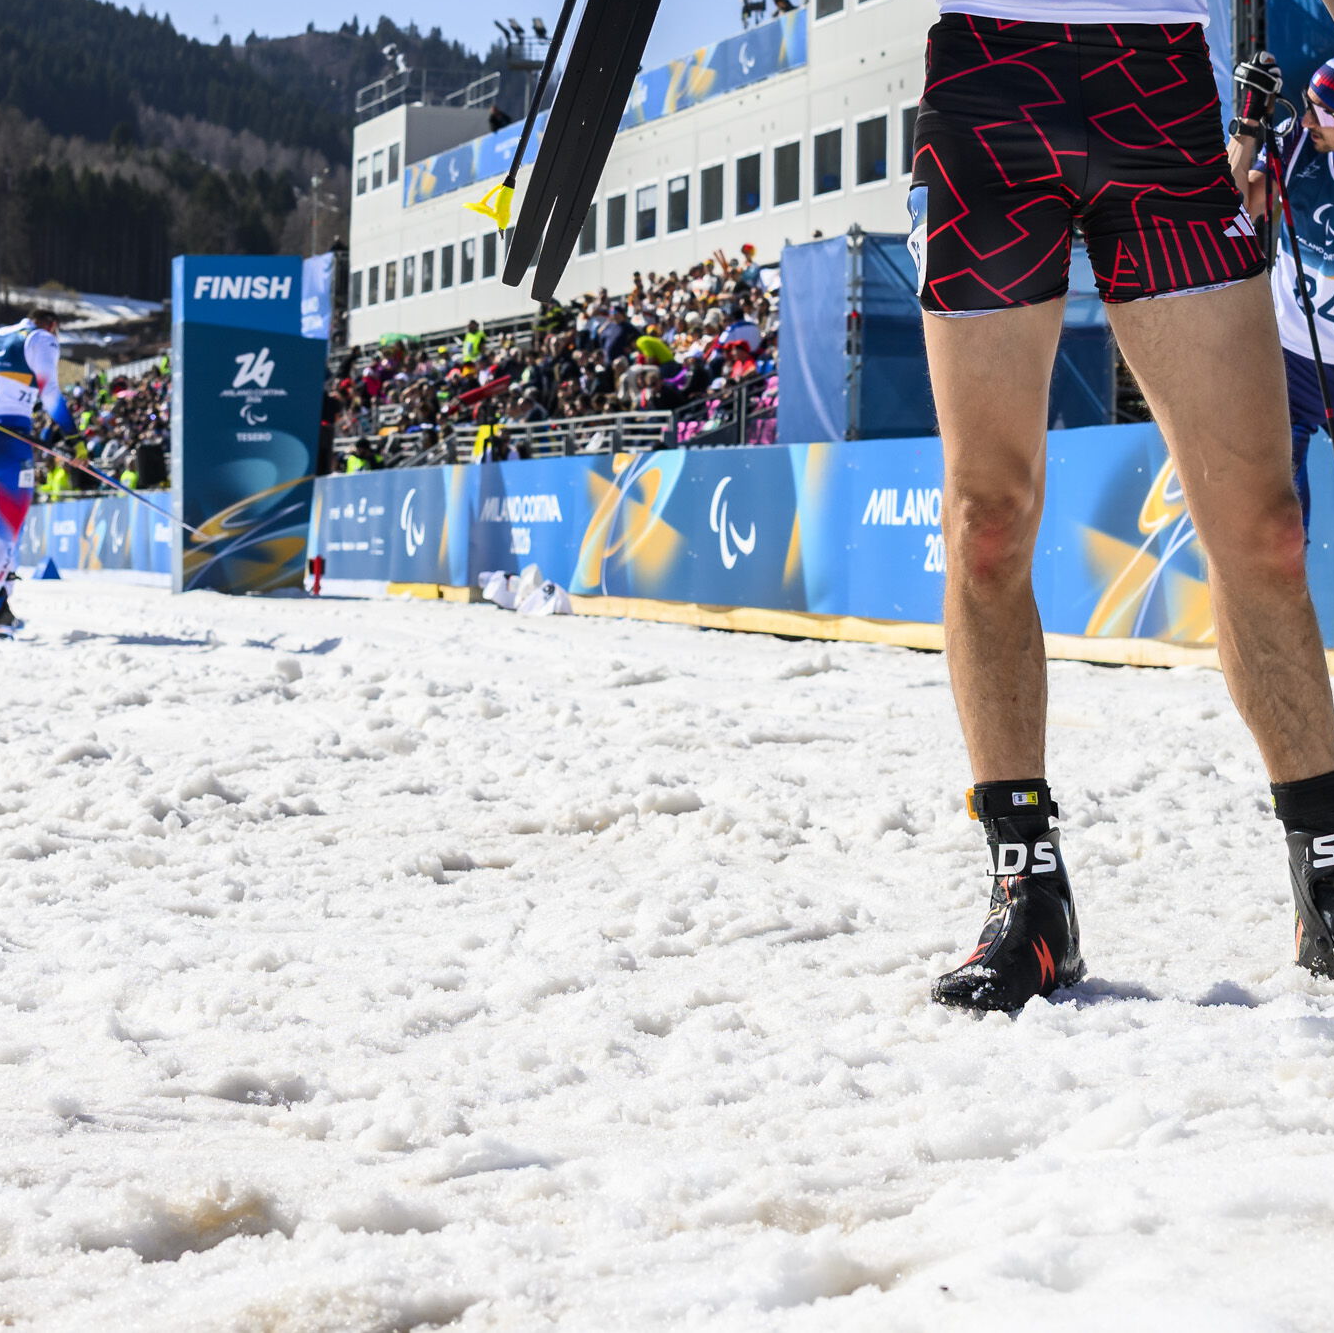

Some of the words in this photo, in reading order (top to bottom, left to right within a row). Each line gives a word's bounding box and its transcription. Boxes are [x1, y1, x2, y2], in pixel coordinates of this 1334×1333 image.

[193, 276, 292, 300] FINISH
[236, 432, 272, 442] TESERO
[861, 488, 942, 526] MILANO
[924, 533, 947, 573] 20
